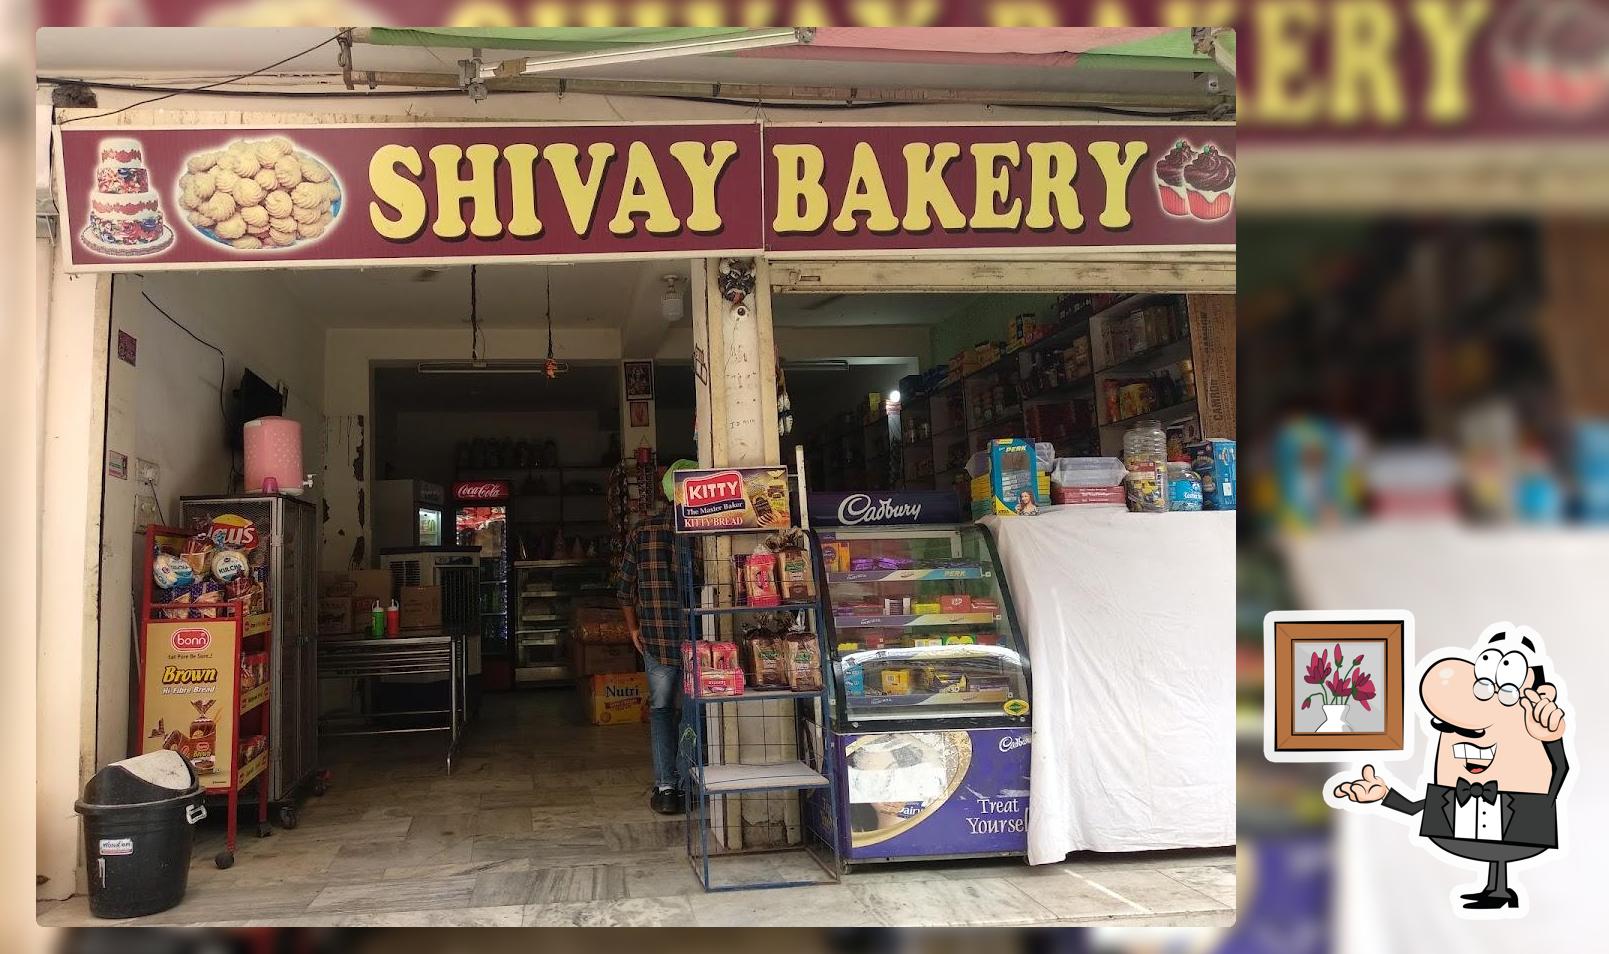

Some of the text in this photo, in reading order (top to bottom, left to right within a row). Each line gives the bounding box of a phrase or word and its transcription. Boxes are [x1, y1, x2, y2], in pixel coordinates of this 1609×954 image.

[368, 140, 1148, 240] SHIVAY BAKERY
[688, 480, 739, 500] KITTY
[686, 501, 743, 516] The Master Baker
[837, 493, 922, 526] Cadbury
[684, 517, 743, 527] KITTY BREAD
[177, 633, 207, 646] bonn
[162, 665, 218, 685] Brown
[606, 685, 640, 697] Nutri
[977, 798, 1020, 814] Treat
[966, 808, 1030, 834] Yoursel
